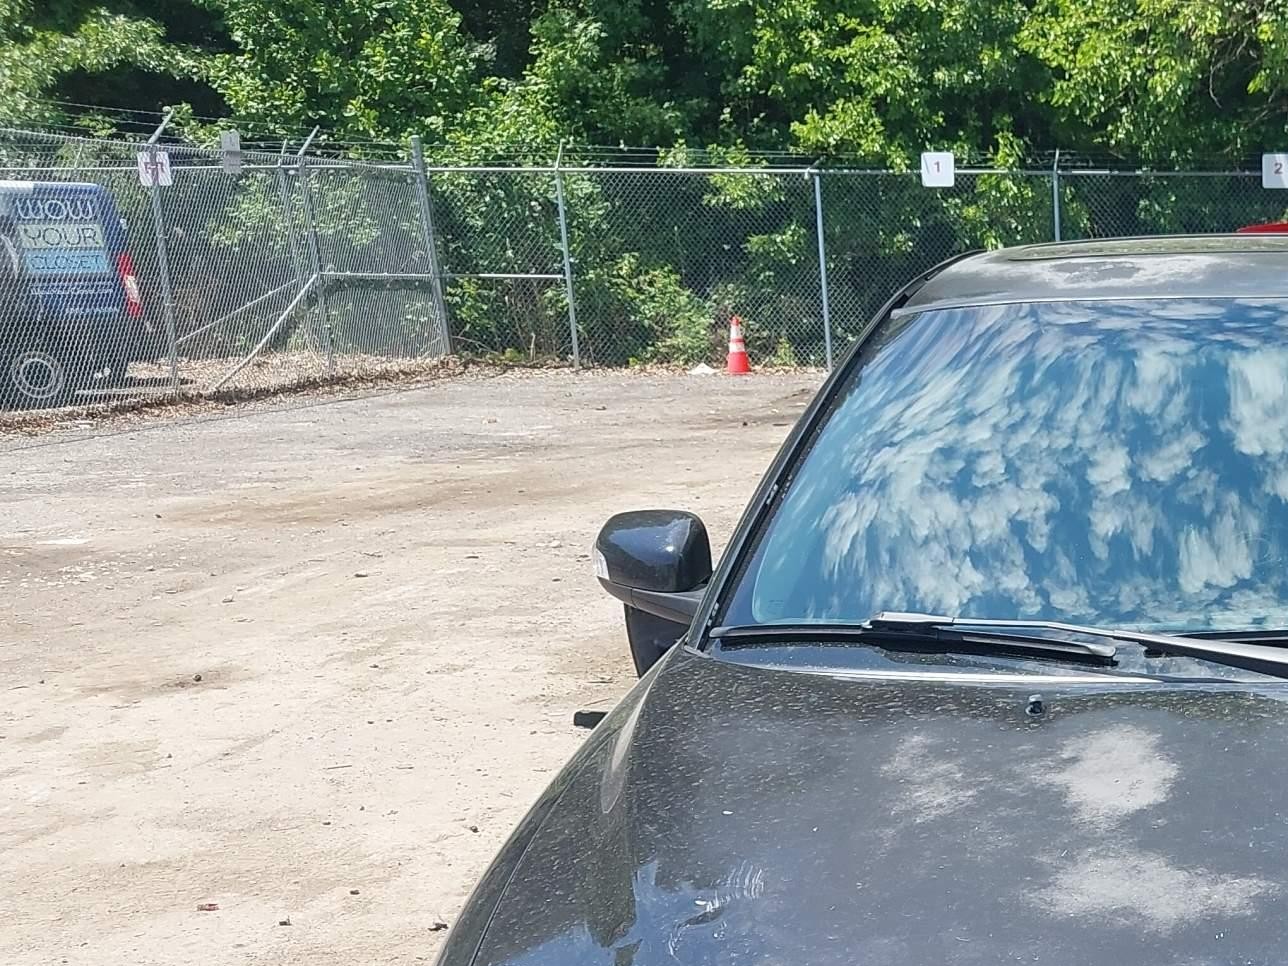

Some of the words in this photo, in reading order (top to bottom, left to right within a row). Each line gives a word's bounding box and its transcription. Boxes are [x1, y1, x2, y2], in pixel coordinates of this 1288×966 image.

[932, 160, 942, 174] 1
[1273, 161, 1284, 175] 2
[16, 198, 93, 219] WOW
[23, 227, 100, 246] YOUR
[31, 255, 103, 270] CLOSET
